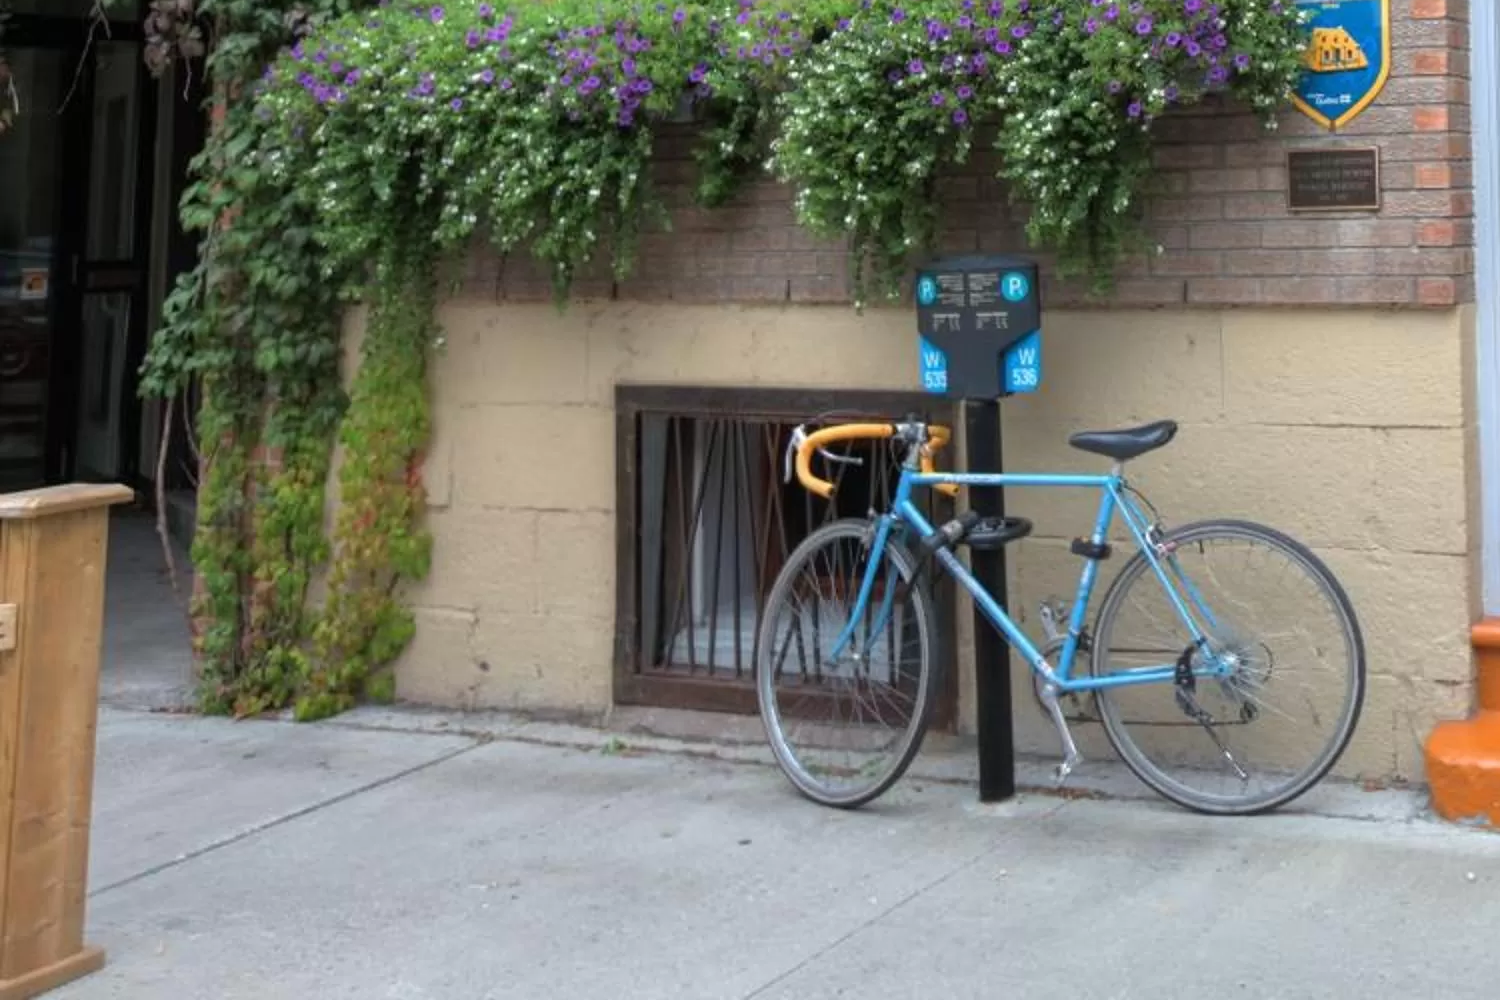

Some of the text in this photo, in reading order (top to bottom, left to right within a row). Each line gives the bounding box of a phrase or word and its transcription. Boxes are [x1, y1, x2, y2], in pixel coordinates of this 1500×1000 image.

[922, 350, 941, 369] W
[1017, 347, 1036, 365] W
[924, 370, 947, 389] 535
[1012, 367, 1038, 386] 536
